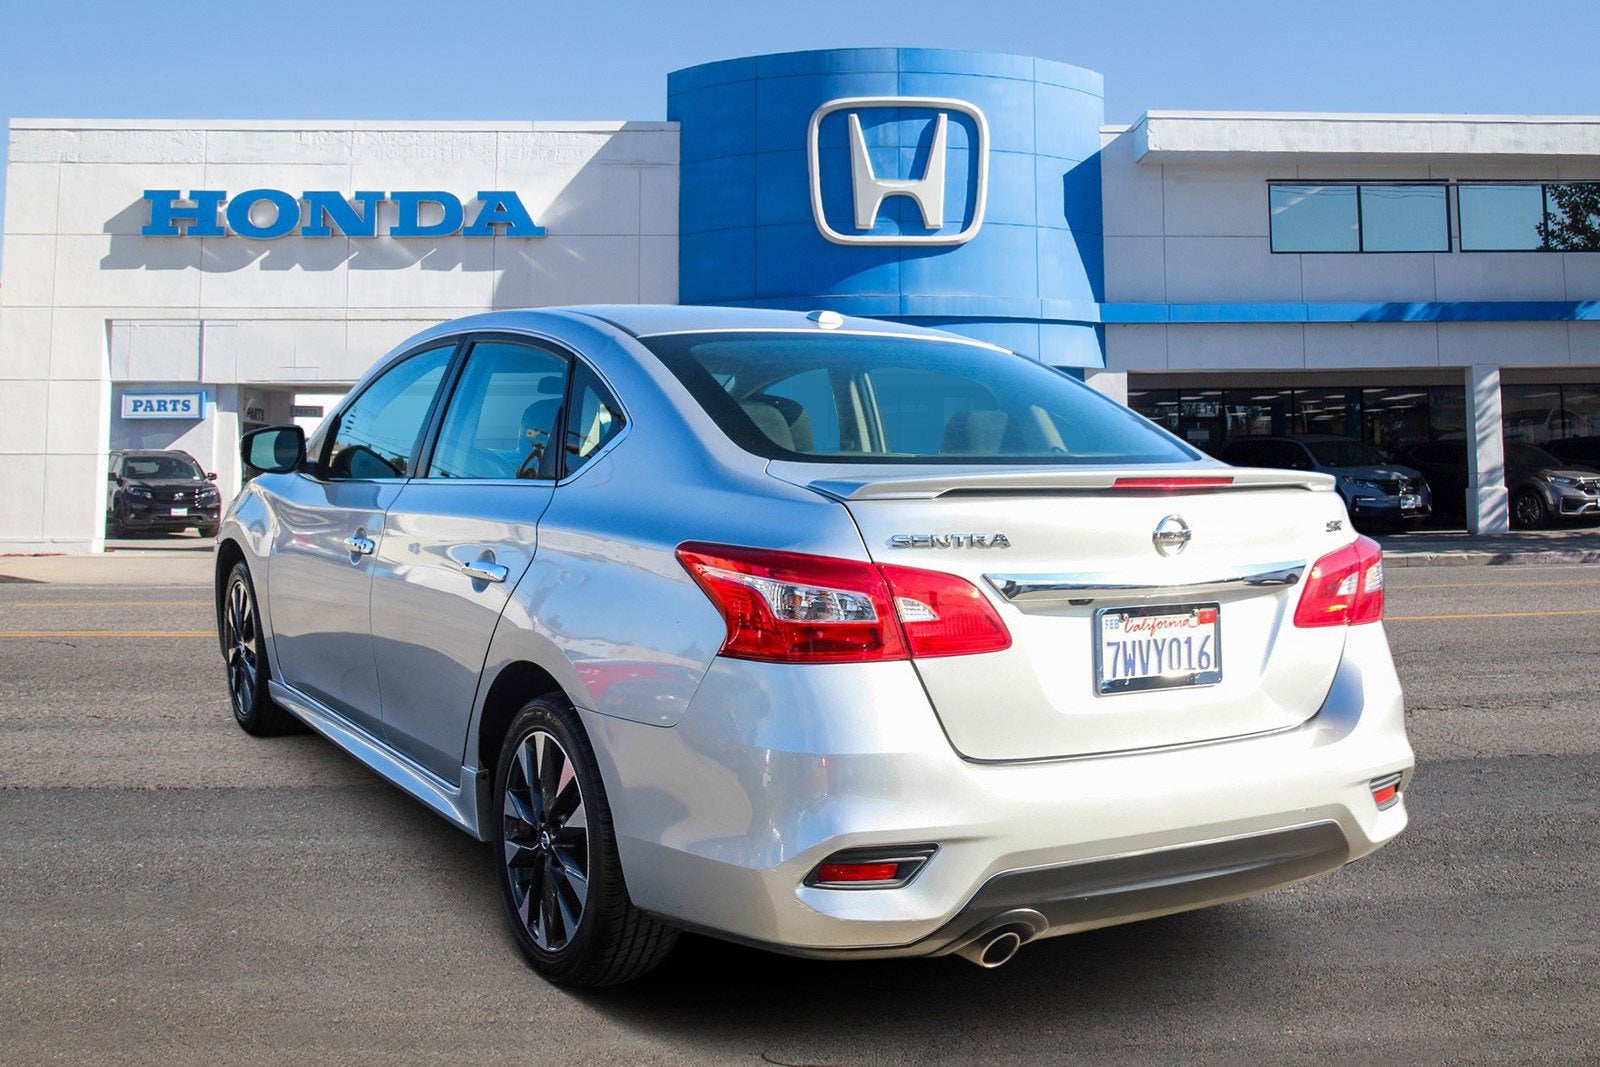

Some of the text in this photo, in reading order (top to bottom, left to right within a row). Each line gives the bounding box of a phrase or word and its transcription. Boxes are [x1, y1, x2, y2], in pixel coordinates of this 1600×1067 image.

[141, 188, 547, 239] HONDA
[131, 399, 191, 412] PARTS
[889, 533, 1011, 549] SENTRA
[1104, 618, 1120, 630] FEB
[1123, 617, 1199, 637] California
[1106, 634, 1212, 679] 7WVY016
